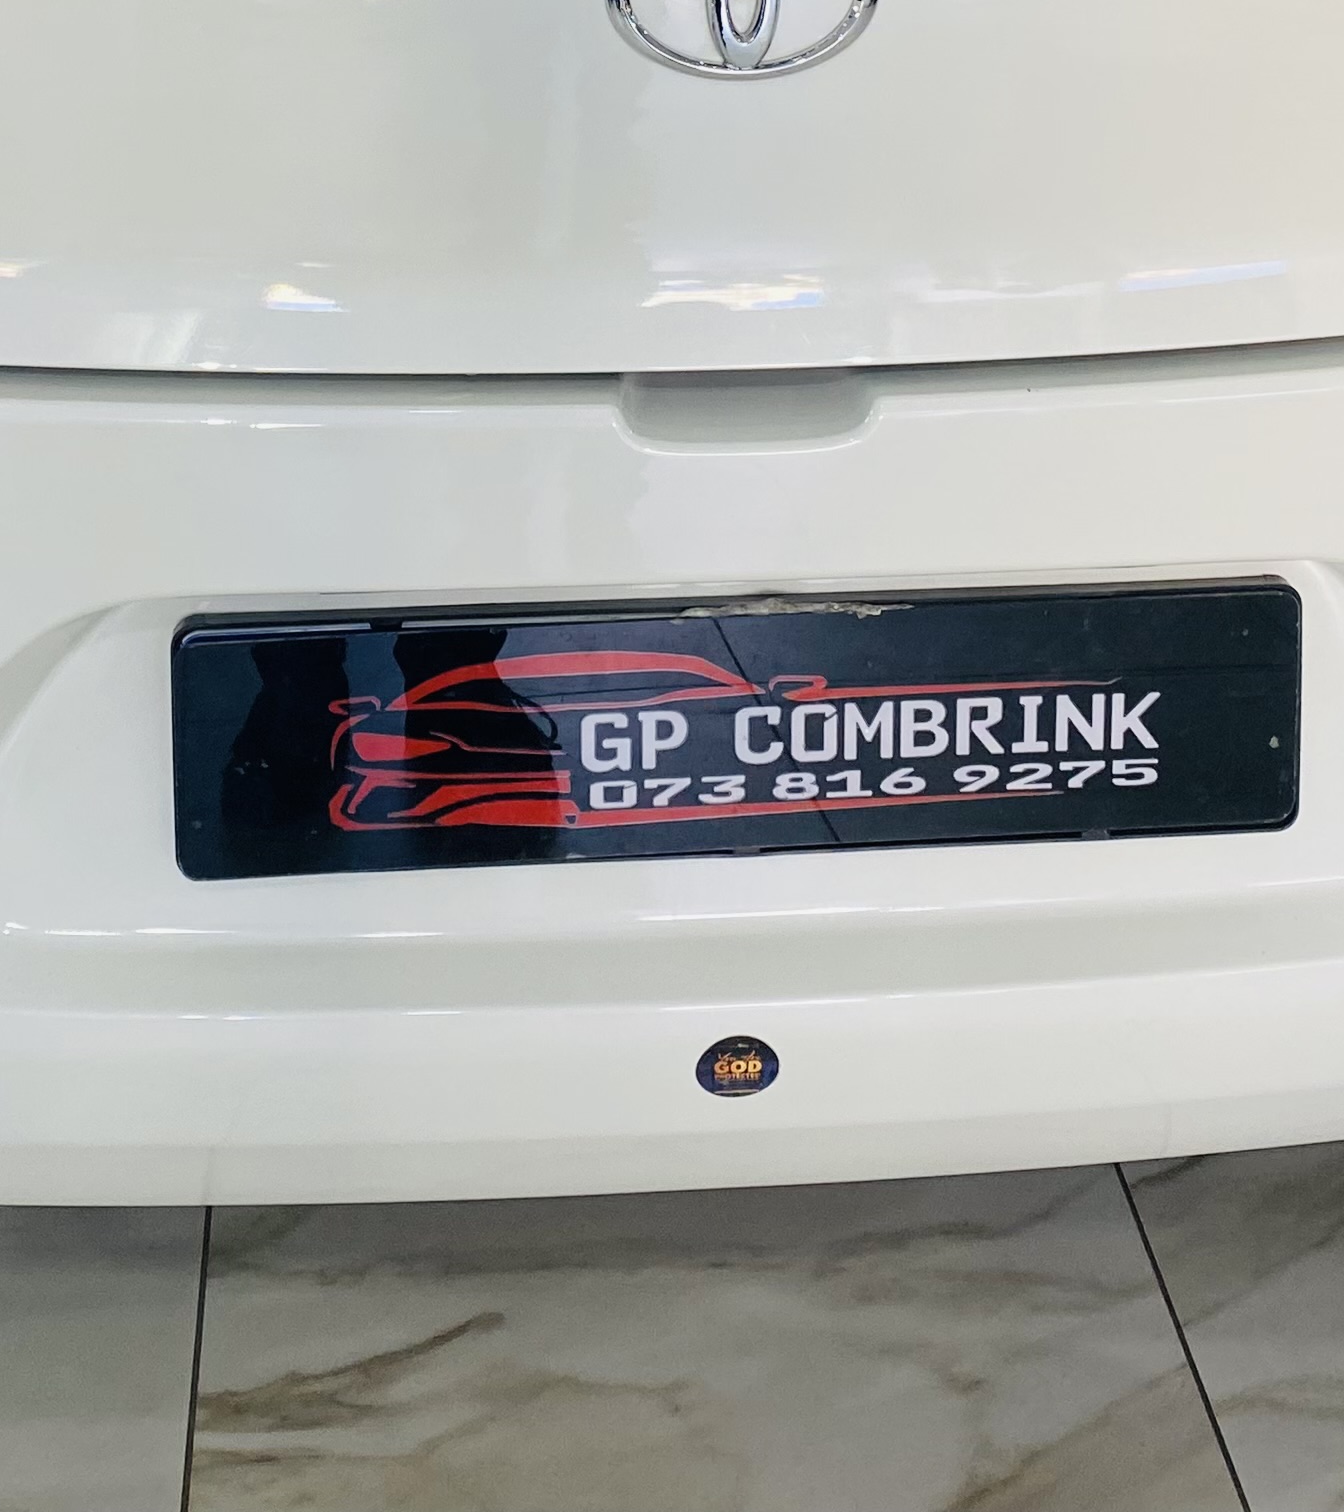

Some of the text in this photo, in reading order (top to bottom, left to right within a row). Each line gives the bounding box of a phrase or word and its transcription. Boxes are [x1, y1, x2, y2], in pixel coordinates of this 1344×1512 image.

[580, 691, 1161, 773] GP COMBRINK
[589, 757, 1159, 810] 073 816 9275
[714, 1060, 763, 1073] GOD
